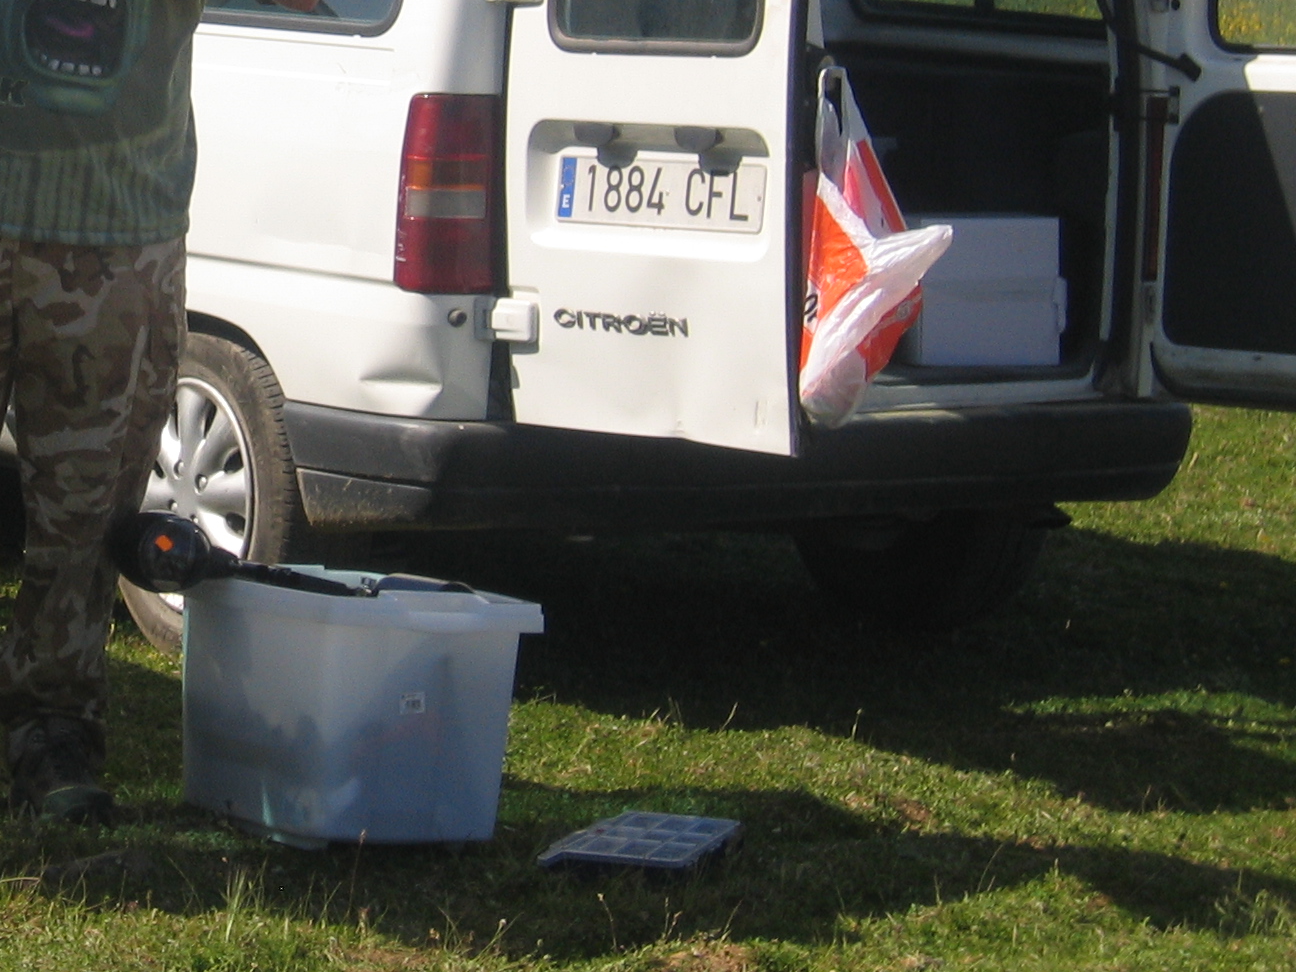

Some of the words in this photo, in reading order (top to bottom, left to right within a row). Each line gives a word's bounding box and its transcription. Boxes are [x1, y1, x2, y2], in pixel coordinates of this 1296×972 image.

[561, 193, 571, 209] E
[587, 164, 665, 216] 1884
[684, 167, 749, 222] CFL
[553, 307, 690, 338] CITROËN
